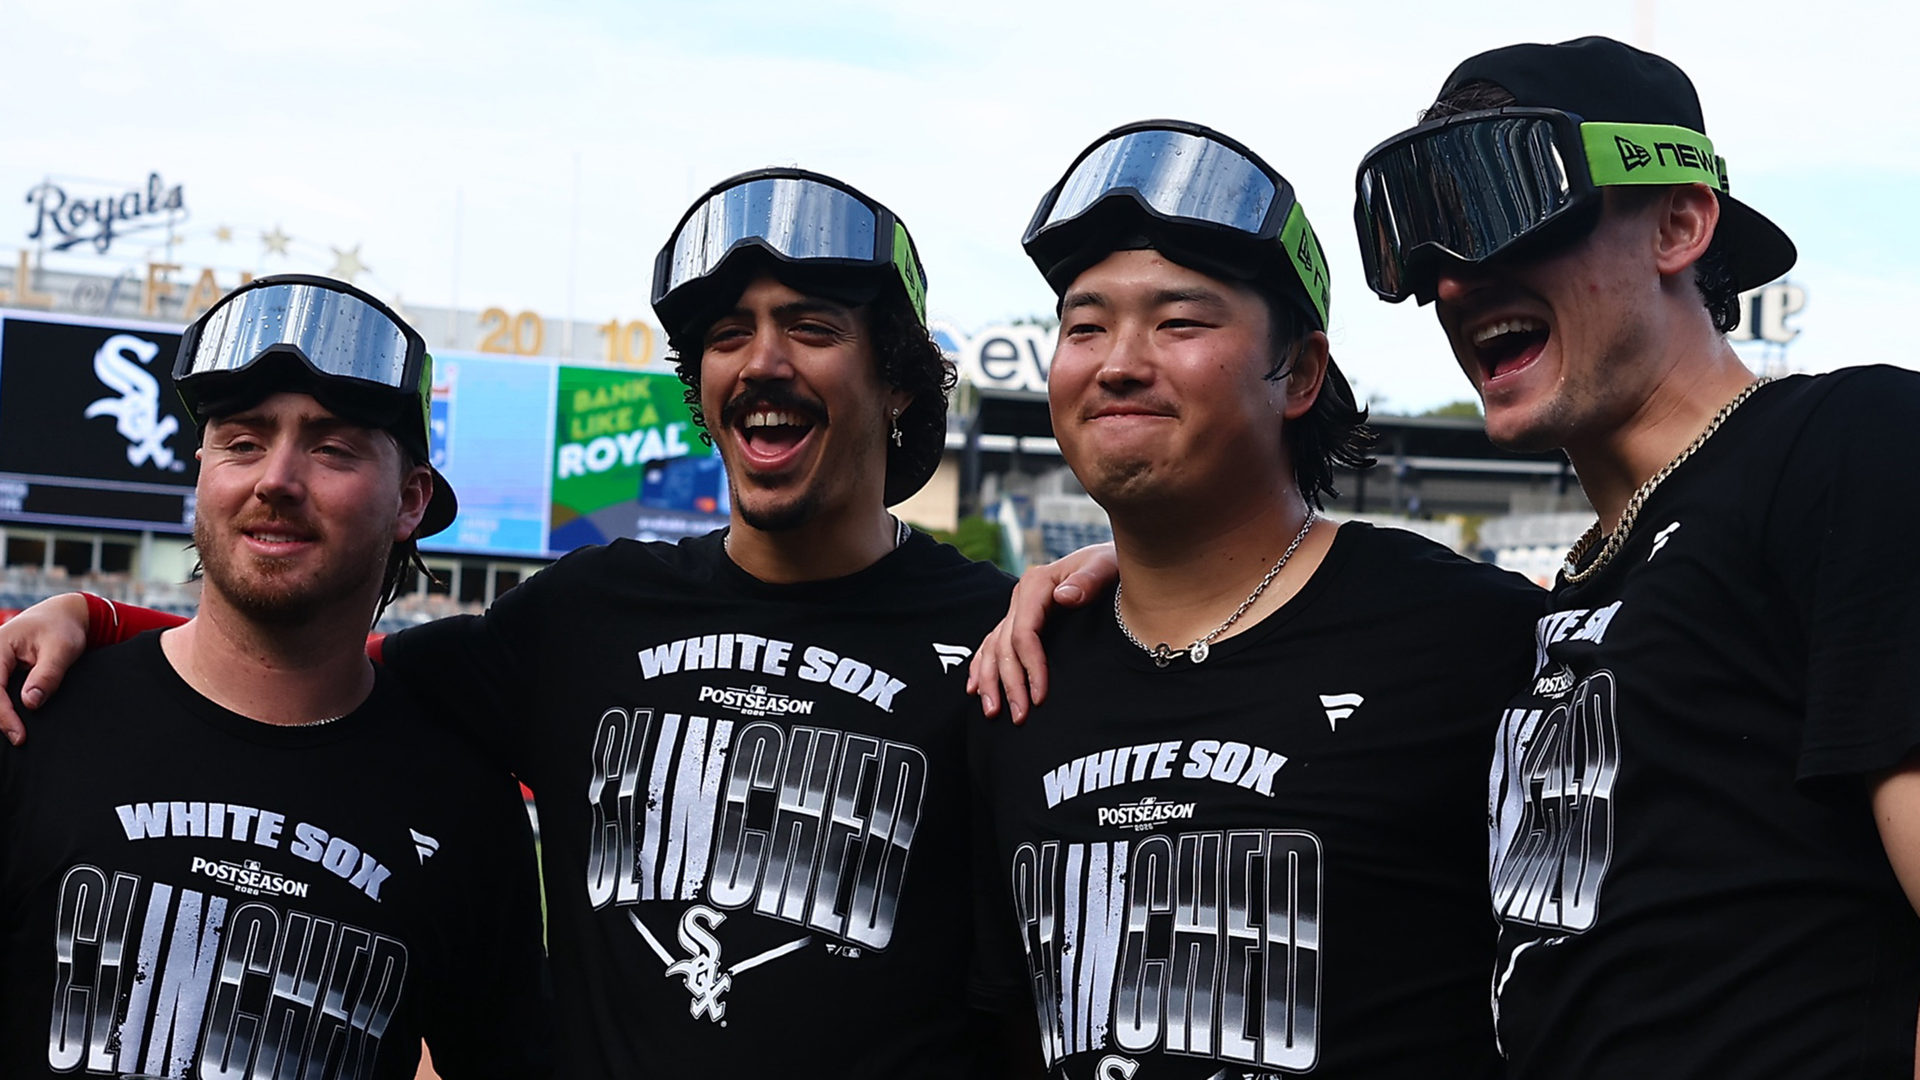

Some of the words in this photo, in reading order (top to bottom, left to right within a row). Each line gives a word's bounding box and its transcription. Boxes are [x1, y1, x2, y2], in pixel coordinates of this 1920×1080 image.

[26, 172, 185, 253] Royals
[141, 261, 254, 319] FA
[478, 307, 544, 357] 20
[599, 319, 654, 365] 10
[571, 407, 633, 440] LIKE
[639, 403, 660, 426] A
[573, 376, 652, 413] BANK
[557, 422, 690, 480] ROYAL
[638, 633, 794, 680] WHITE
[799, 645, 908, 712] SOX
[698, 686, 815, 715] POSTSEASON
[1043, 740, 1183, 810] WHITE
[1182, 740, 1289, 798] SOX
[586, 707, 929, 954] CLINCHED
[1097, 803, 1196, 827] POSTSEASON
[115, 801, 286, 849] WHITE
[290, 822, 393, 901] SOX
[190, 856, 309, 898] POSTSEASON
[47, 863, 409, 1080] CLINCHED
[1011, 829, 1324, 1075] CLINCHED
